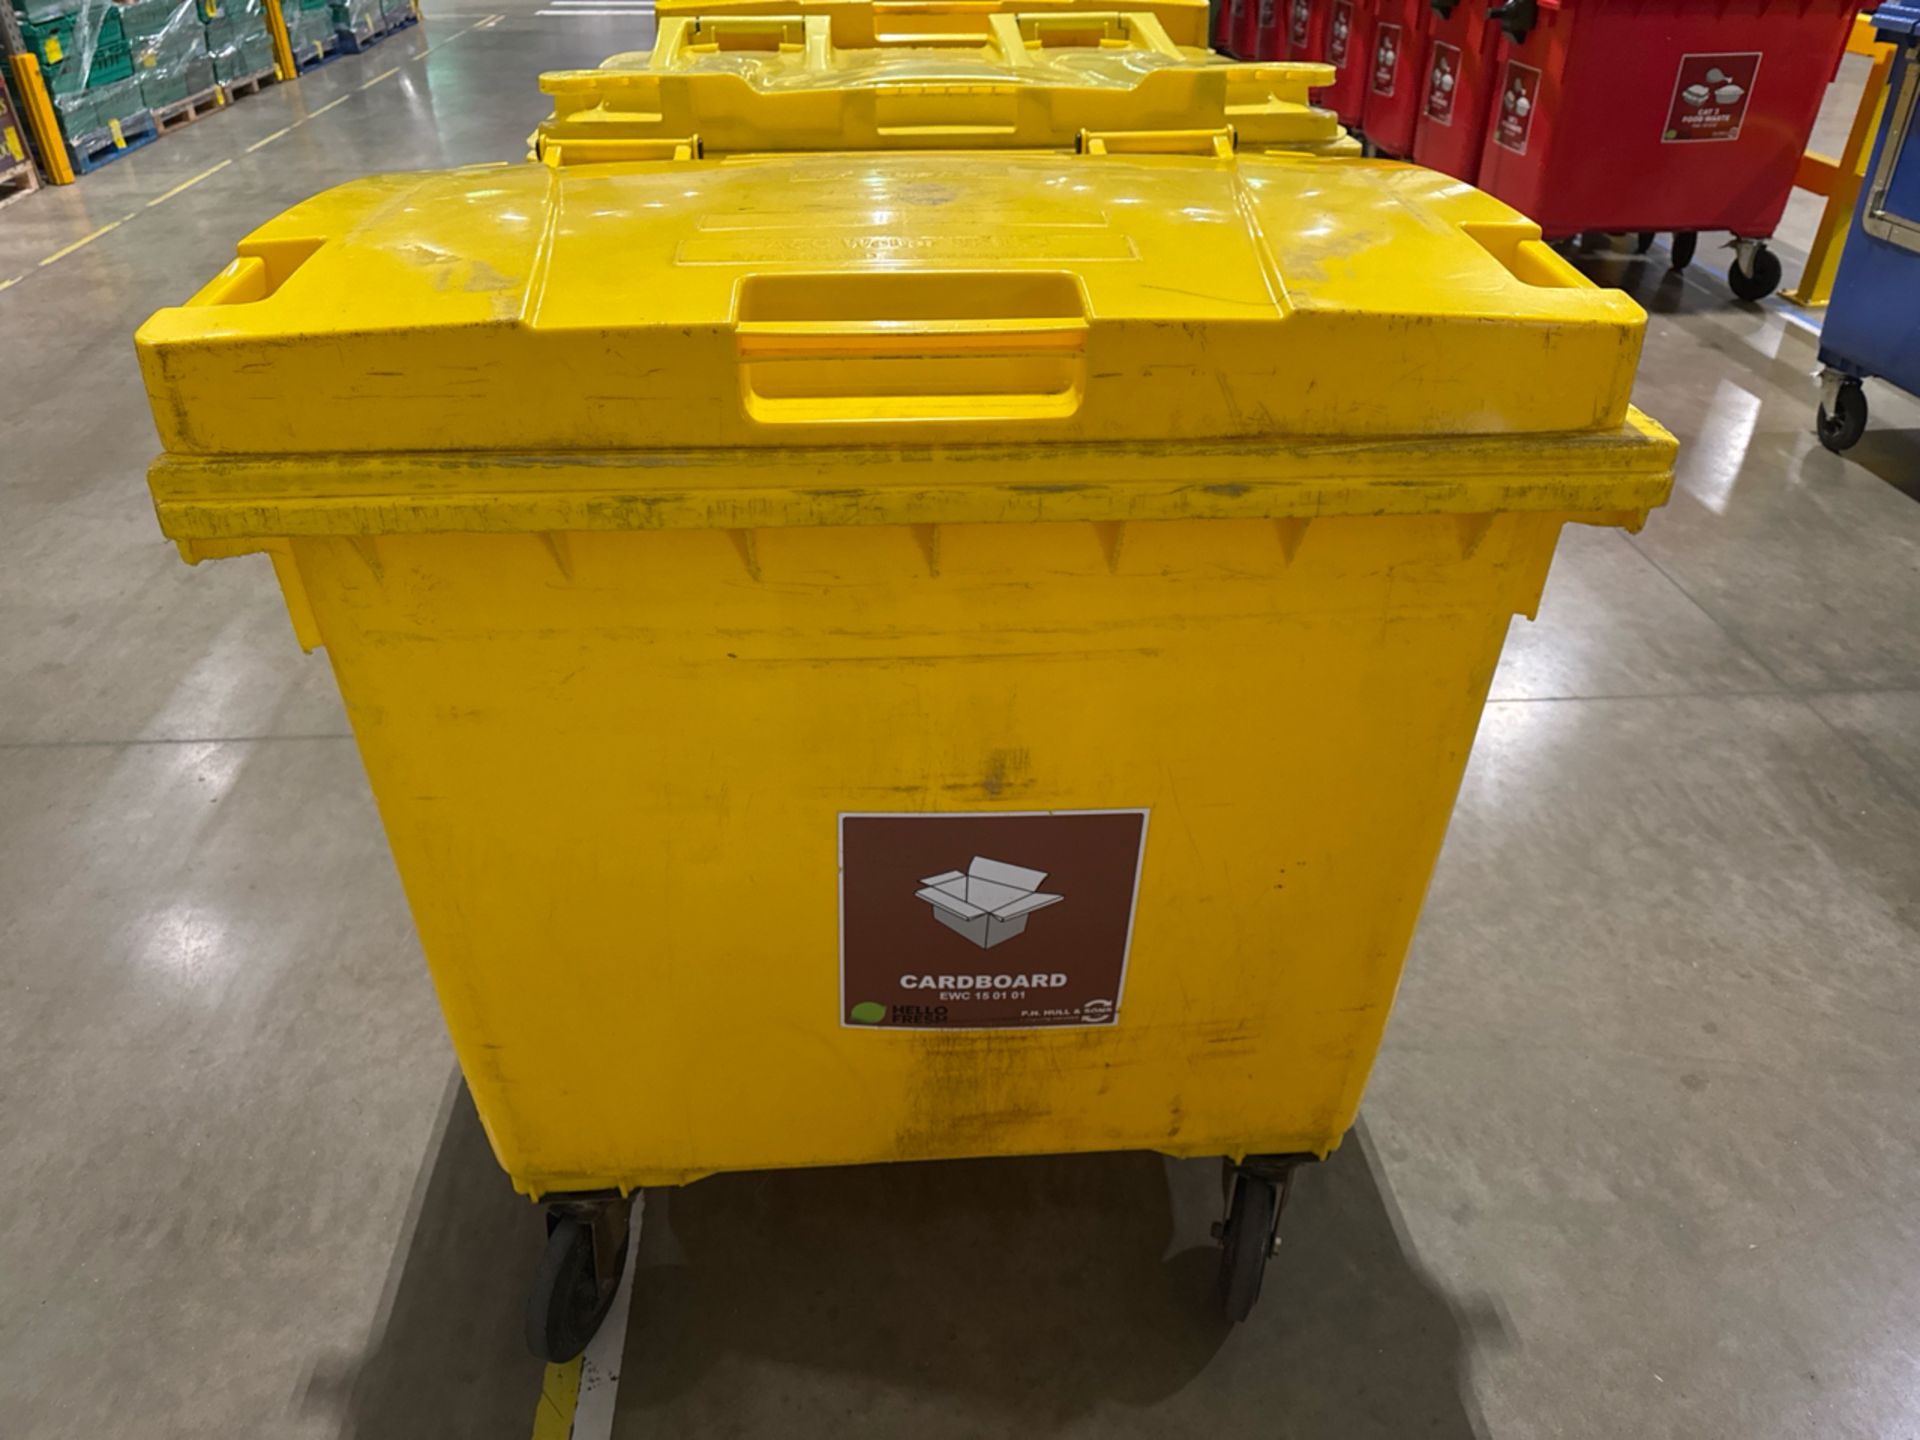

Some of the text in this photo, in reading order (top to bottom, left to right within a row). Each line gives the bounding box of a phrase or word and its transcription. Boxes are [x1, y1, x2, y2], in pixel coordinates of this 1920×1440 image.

[900, 974, 1068, 989] CARDBOARD
[940, 990, 1026, 1000] EWC 15 01 01
[892, 1004, 949, 1015] HELLO
[1043, 1008, 1070, 1016] HULL
[891, 1014, 948, 1024] FRESH
